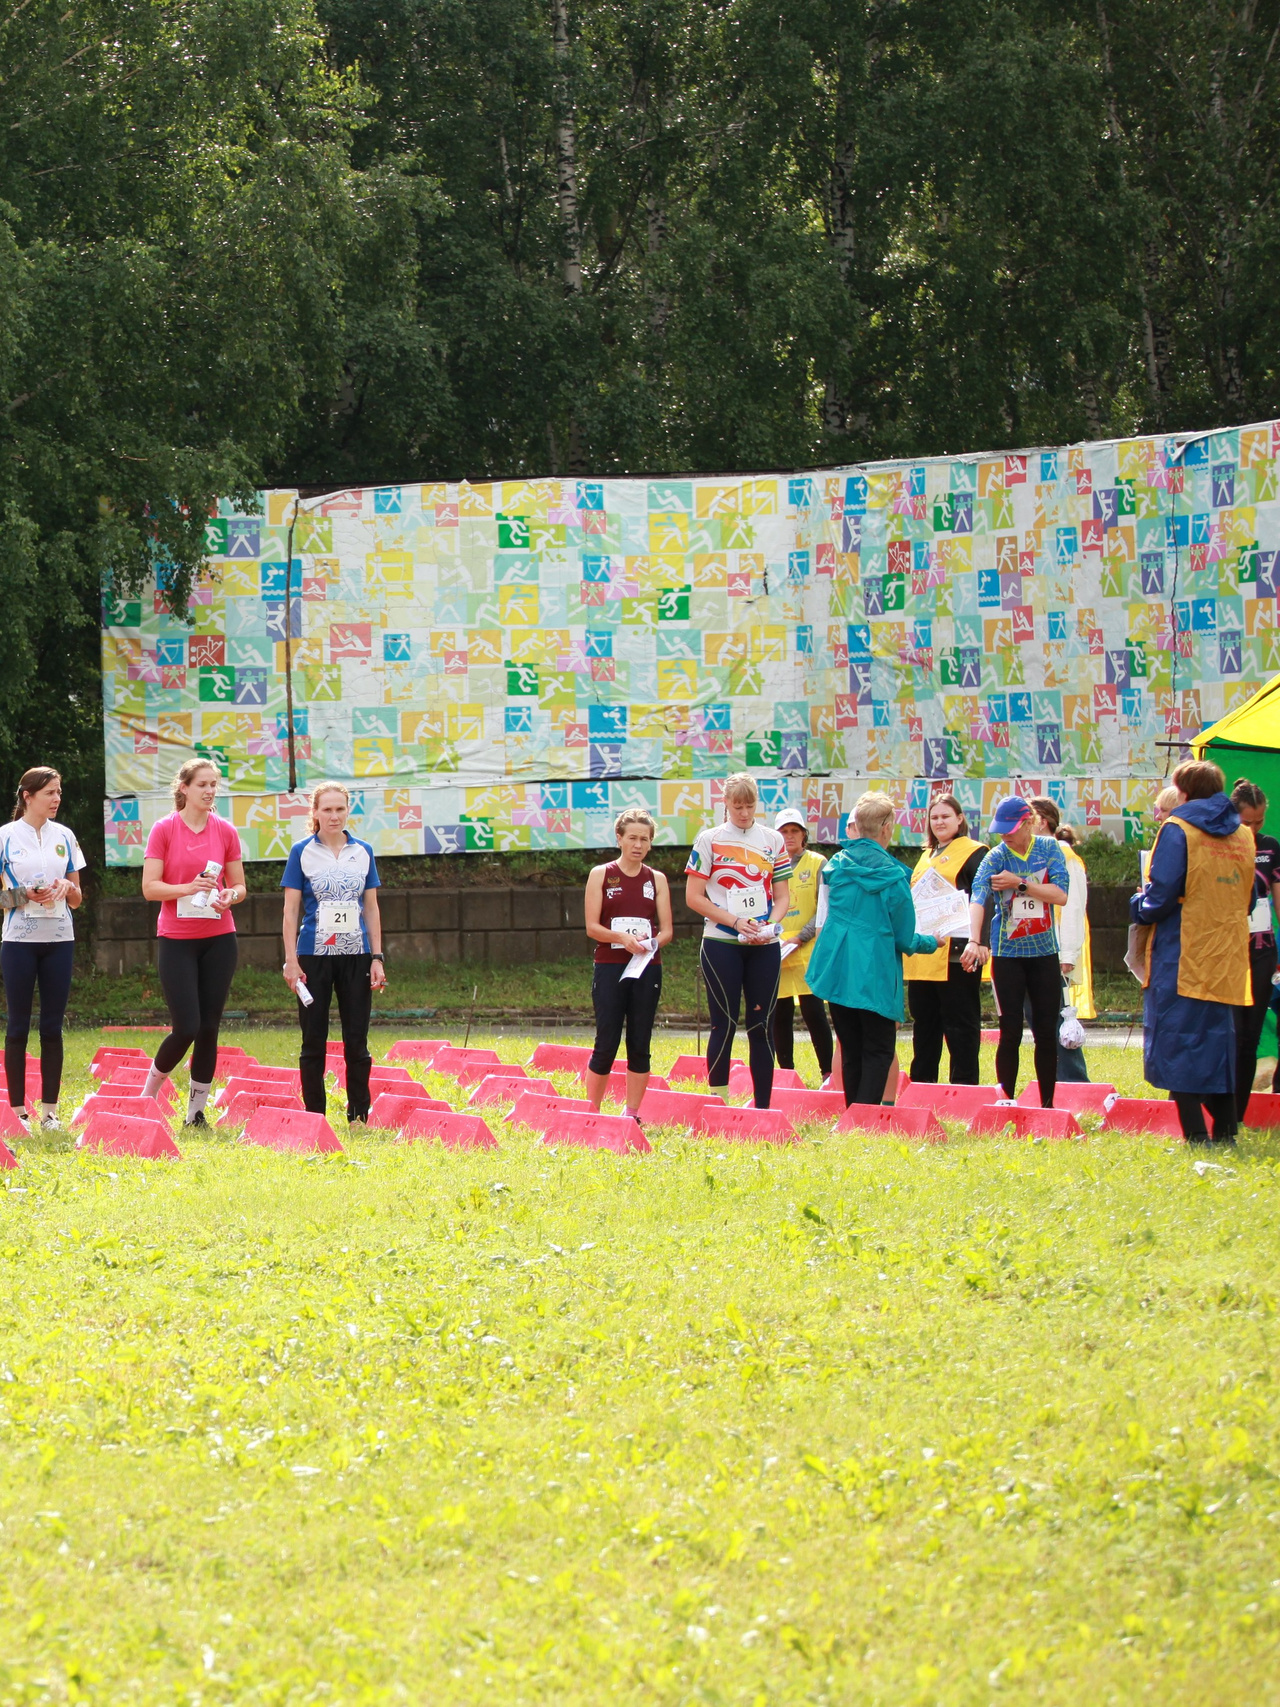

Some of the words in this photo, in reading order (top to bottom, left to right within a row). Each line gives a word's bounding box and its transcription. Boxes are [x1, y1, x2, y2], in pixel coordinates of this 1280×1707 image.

[742, 897, 755, 908] 18
[1021, 900, 1035, 910] 16
[334, 912, 347, 923] 21
